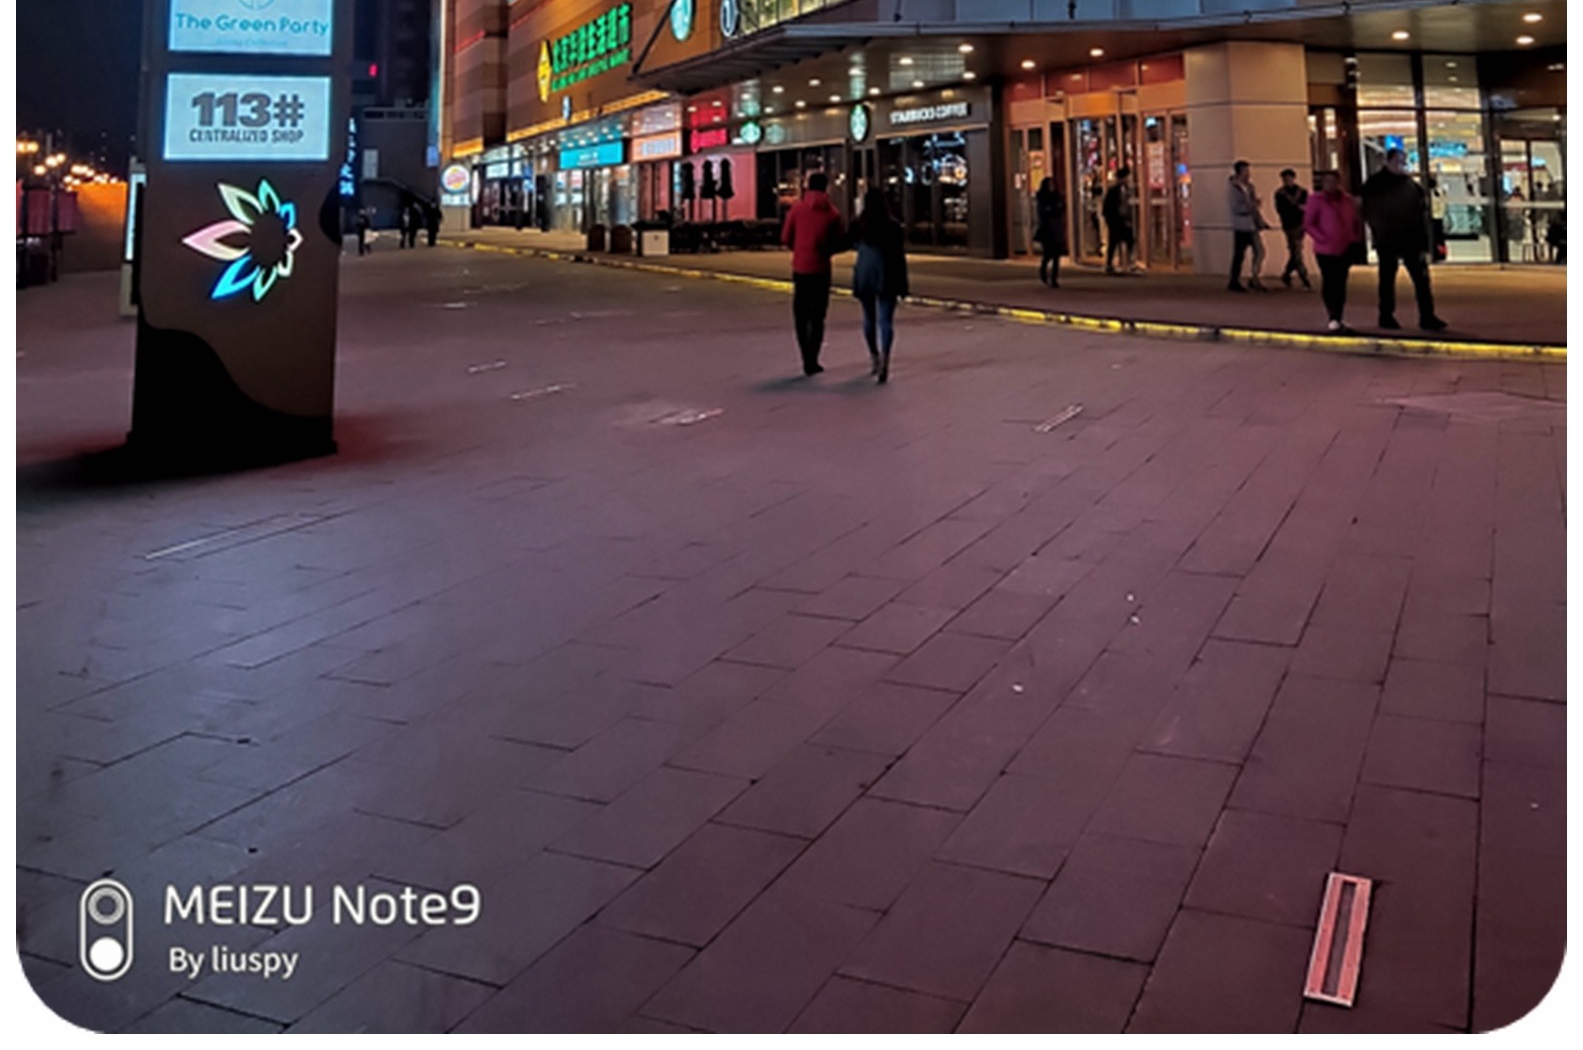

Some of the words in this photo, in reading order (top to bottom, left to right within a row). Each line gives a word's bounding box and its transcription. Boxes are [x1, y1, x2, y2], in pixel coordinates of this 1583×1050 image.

[175, 12, 212, 31] The
[215, 14, 277, 32] Green
[279, 16, 329, 37] Party
[191, 91, 305, 128] 113#
